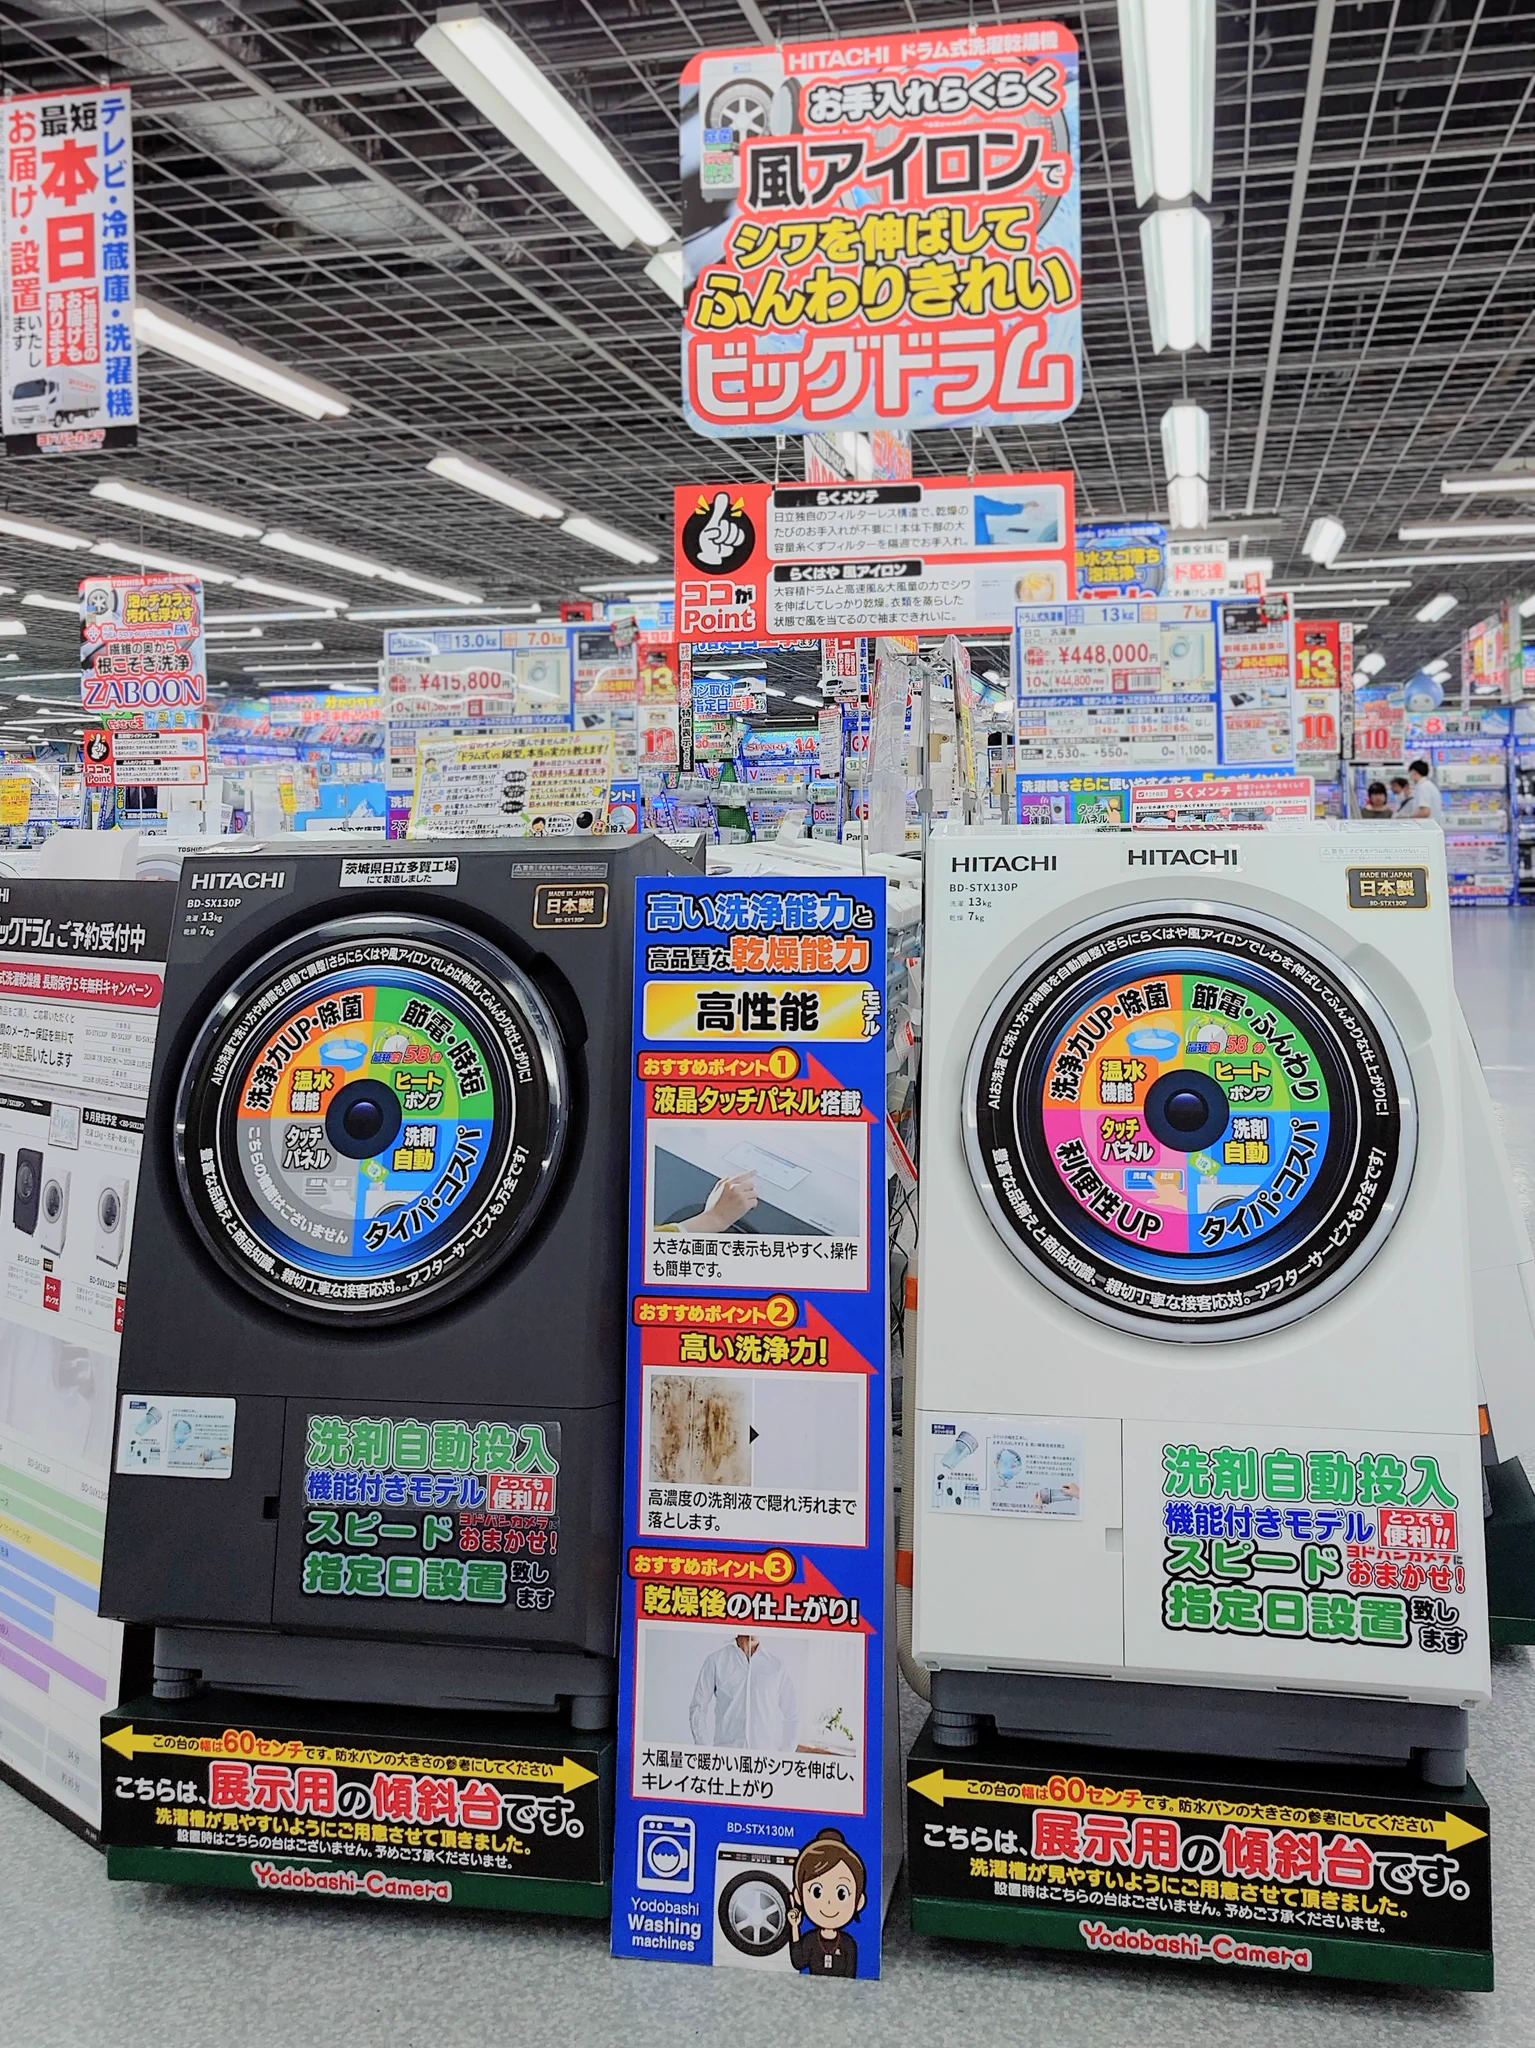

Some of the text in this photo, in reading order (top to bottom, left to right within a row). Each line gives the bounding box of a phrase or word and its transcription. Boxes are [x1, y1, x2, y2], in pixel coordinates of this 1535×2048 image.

[788, 31, 1058, 71] HITACHI ドラム式洗濯乾燥機
[807, 67, 1059, 123] お手入れらくらく
[40, 101, 99, 137] 最短
[748, 131, 1064, 211] 風アイロンで
[8, 108, 42, 314] お届け・設置
[41, 139, 100, 283] 本日
[734, 207, 1031, 268] シワを伸ばして
[100, 97, 134, 418] テレビ・冷蔵庫・洗濯機
[695, 255, 1072, 330] ふんわりきれい
[696, 325, 1066, 417] ビッグドラム
[816, 490, 879, 506] らくメンテ
[773, 505, 969, 523] 日立独自のフィルターレス構造で、乾燥の
[773, 521, 966, 538] たびのお手入れが不要に!本体下部の大
[773, 536, 969, 554] 容量糸くずフィルターを隔週でお手入れ。
[789, 563, 907, 582] らくはや 風アイロン
[681, 581, 754, 607] ココが
[773, 579, 971, 597] 大容積ドラムと高速風&大風量の力でシワ
[127, 592, 193, 609] 泡のチカラで
[773, 595, 964, 612] を伸ばしてしっかり乾燥。衣類を蒸らした
[126, 606, 194, 624] 汚れを浮かす
[681, 608, 757, 634] Point
[773, 610, 957, 628] 状態で風を当てるので袖まできれいに。
[109, 642, 176, 655] 繊維の奥から
[97, 655, 190, 674] 根こそぎ洗浄
[85, 678, 202, 707] ZABOON
[88, 775, 112, 784] Point
[1173, 786, 1232, 799] らくメンテ
[1023, 805, 1050, 816] スマホ
[1077, 804, 1104, 815] タッチ
[344, 859, 458, 876] 茨城県日立多賀工場
[951, 855, 1058, 873] HITACHI
[1127, 847, 1239, 867] HITACHI
[191, 872, 286, 891] HITACHI
[366, 873, 432, 885] にて製造しました
[949, 882, 1019, 893] BD-STX130P
[1359, 879, 1416, 897] 日本製
[186, 898, 242, 909] BD-SX130P
[546, 897, 594, 915] 日本製
[646, 893, 875, 931] 高い洗浄能力と
[968, 896, 992, 909] 13kg
[201, 911, 223, 924] 13kg
[967, 911, 986, 923] 7kg
[57, 920, 147, 954] ご予約受付中
[200, 925, 215, 937] 7kg
[647, 935, 870, 974] 高品質な乾燥能力
[42, 974, 154, 998] 長期保守5年無料キャンペーン
[695, 989, 881, 1037] 高性能 モデル
[245, 992, 364, 1111] 洗浄力UP・除菌
[400, 997, 489, 1100] 節電・時短
[1048, 980, 1171, 1103] 洗浄力UP・除菌
[1191, 981, 1321, 1102] 節電・ふんわり
[293, 1069, 335, 1092] 温水
[395, 1070, 444, 1092] ヒート
[1100, 1059, 1147, 1083] 温水
[1215, 1060, 1272, 1083] ヒート
[291, 1091, 321, 1113] 機能
[404, 1090, 444, 1111] ポンプ
[653, 1085, 862, 1117] 液晶タッチパネル搭載
[1100, 1082, 1135, 1103] 機能
[1228, 1084, 1272, 1102] ポンプ
[285, 1125, 325, 1148] タッチ
[403, 1125, 438, 1149] 洗剤
[1100, 1117, 1141, 1140] タッチ
[1232, 1116, 1269, 1140] 洗剤
[282, 1149, 332, 1171] パネル
[393, 1149, 436, 1173] 自動
[1101, 1141, 1155, 1164] パネル
[1223, 1140, 1271, 1166] 自動
[248, 1126, 349, 1245] こちらの機能はございません
[363, 1125, 484, 1252] タイパ・コスパ
[1056, 1138, 1164, 1242] 利便性UP
[1198, 1117, 1320, 1248] タイパ・コスパ
[652, 1237, 859, 1261] 大きな画面で表示も見やすく、操作
[652, 1259, 723, 1279] も簡単です。
[679, 1331, 829, 1367] 高い洗浄力!
[306, 1414, 560, 1476] 洗剤自動投入
[495, 1476, 545, 1491] とっても
[1161, 1444, 1460, 1509] 洗剤自動投入
[304, 1471, 487, 1509] 機能付きモデル
[491, 1489, 549, 1512] 便利!!
[648, 1488, 858, 1516] 高濃度の洗剤液で隠れ汚れまで
[304, 1510, 454, 1552] スピード
[648, 1510, 722, 1532] 落とします。
[1164, 1501, 1376, 1545] 機能付きモデル
[1388, 1511, 1445, 1527] とっても
[457, 1528, 558, 1556] おまかせ!
[1383, 1524, 1451, 1549] 便利!!
[510, 1562, 550, 1584] 致し
[1163, 1537, 1344, 1589] スピード
[302, 1551, 507, 1604] 指定日設置
[1347, 1558, 1466, 1594] おまかせ!
[516, 1586, 555, 1611] ます
[643, 1584, 860, 1626] 乾燥後の仕上がり!
[1162, 1580, 1412, 1648] 指定日設置
[1412, 1597, 1460, 1625] 致し
[1420, 1628, 1468, 1655] ます
[642, 1746, 857, 1783] 大風量で暖かい風がシワを伸ばし、
[641, 1772, 775, 1800] キレイな仕上がり
[155, 1806, 533, 1857] 洗濯槽が見やすいようにご用意させて頂きました。
[726, 1821, 796, 1838] BD-STX130M
[176, 1828, 515, 1872] 設置時はこちらの台はございません。予めご了承くださいませ。
[251, 1860, 453, 1902] Yodobashi-Camera
[969, 1857, 1410, 1919] 洗濯槽が見やすいようにご用意させて頂きました。
[631, 1896, 700, 1917] Yodobashi
[993, 1881, 1388, 1935] 設置時はこちらの台はございません。予めご了承くださいませ。
[627, 1913, 703, 1941] Washing
[631, 1934, 696, 1952] machines
[1078, 1918, 1314, 1973] Yodobashi-Camera
